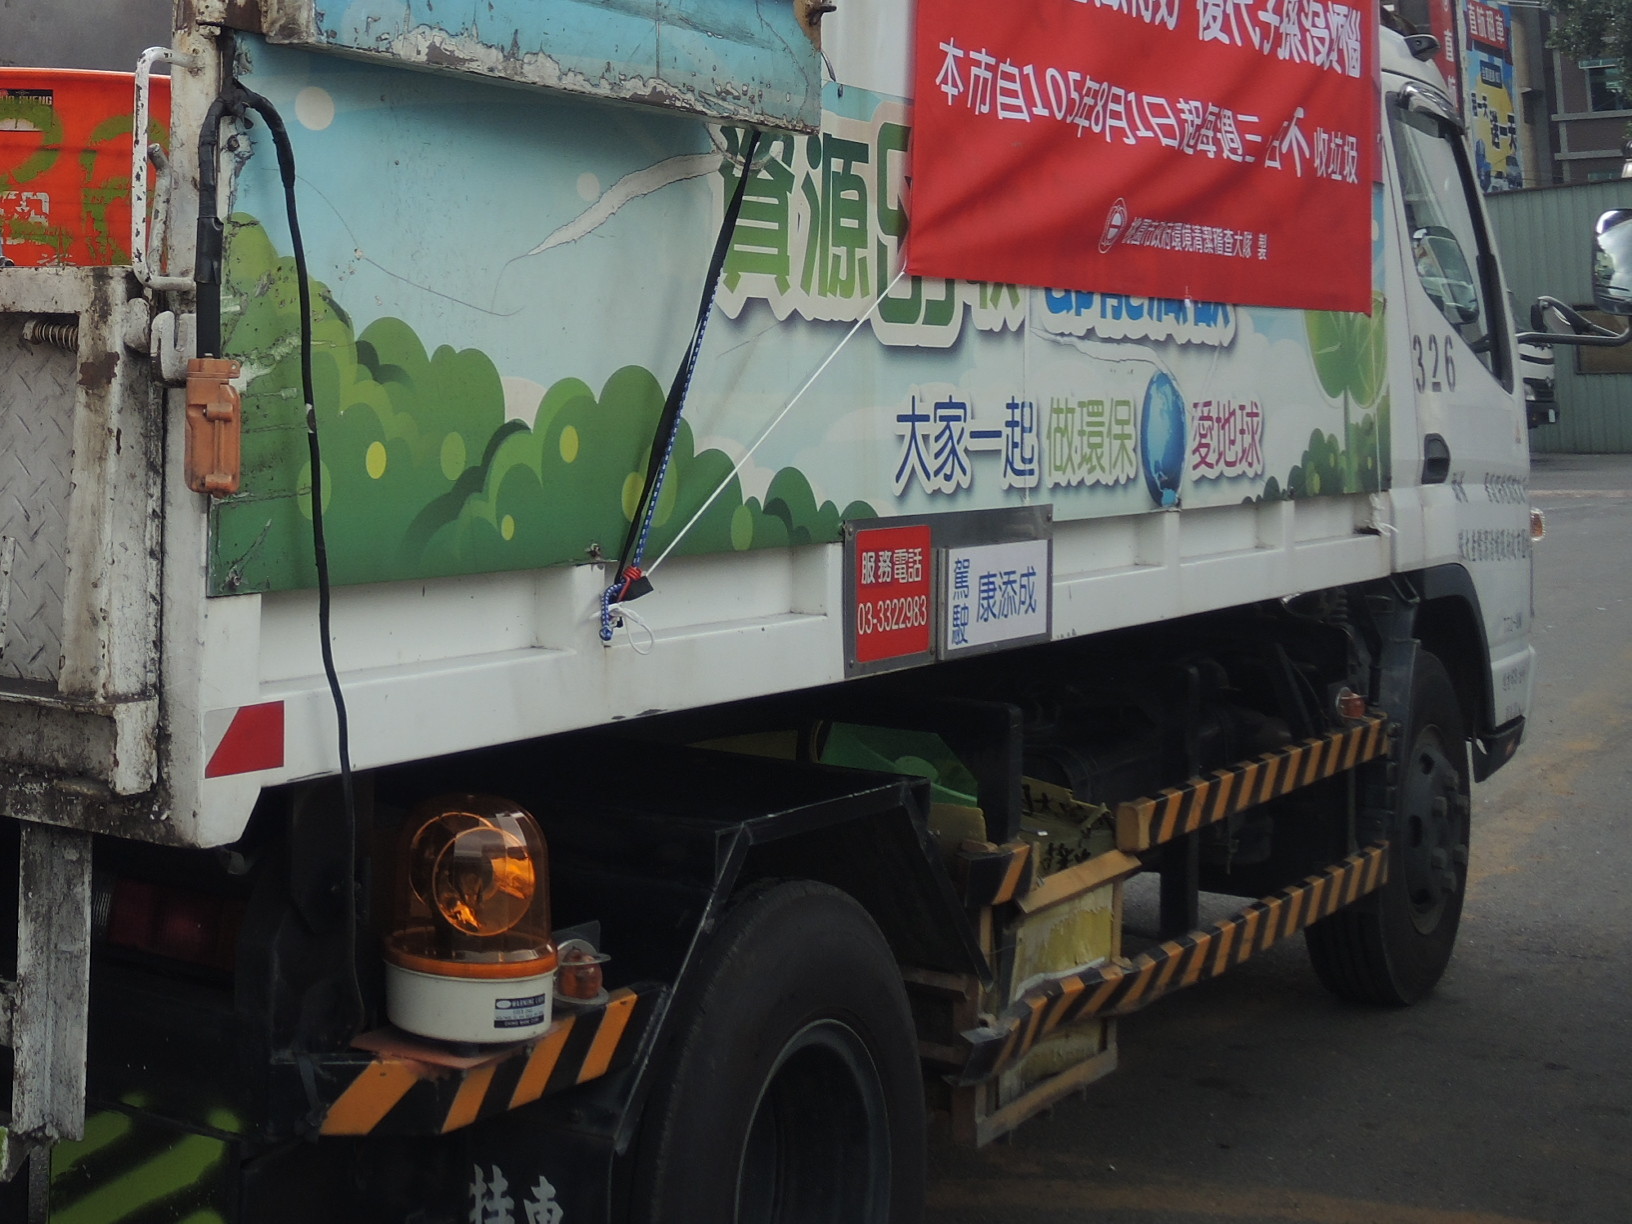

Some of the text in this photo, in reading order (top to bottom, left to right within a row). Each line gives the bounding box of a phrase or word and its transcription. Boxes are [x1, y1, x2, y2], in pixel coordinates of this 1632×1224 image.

[1412, 333, 1456, 394] 326
[895, 393, 1261, 485] 大家一起 做環保 愛地球
[861, 547, 922, 585] 服務電話
[976, 565, 1037, 623] 康添成
[857, 594, 927, 636] 03-3322983
[952, 557, 970, 646] 駕駛
